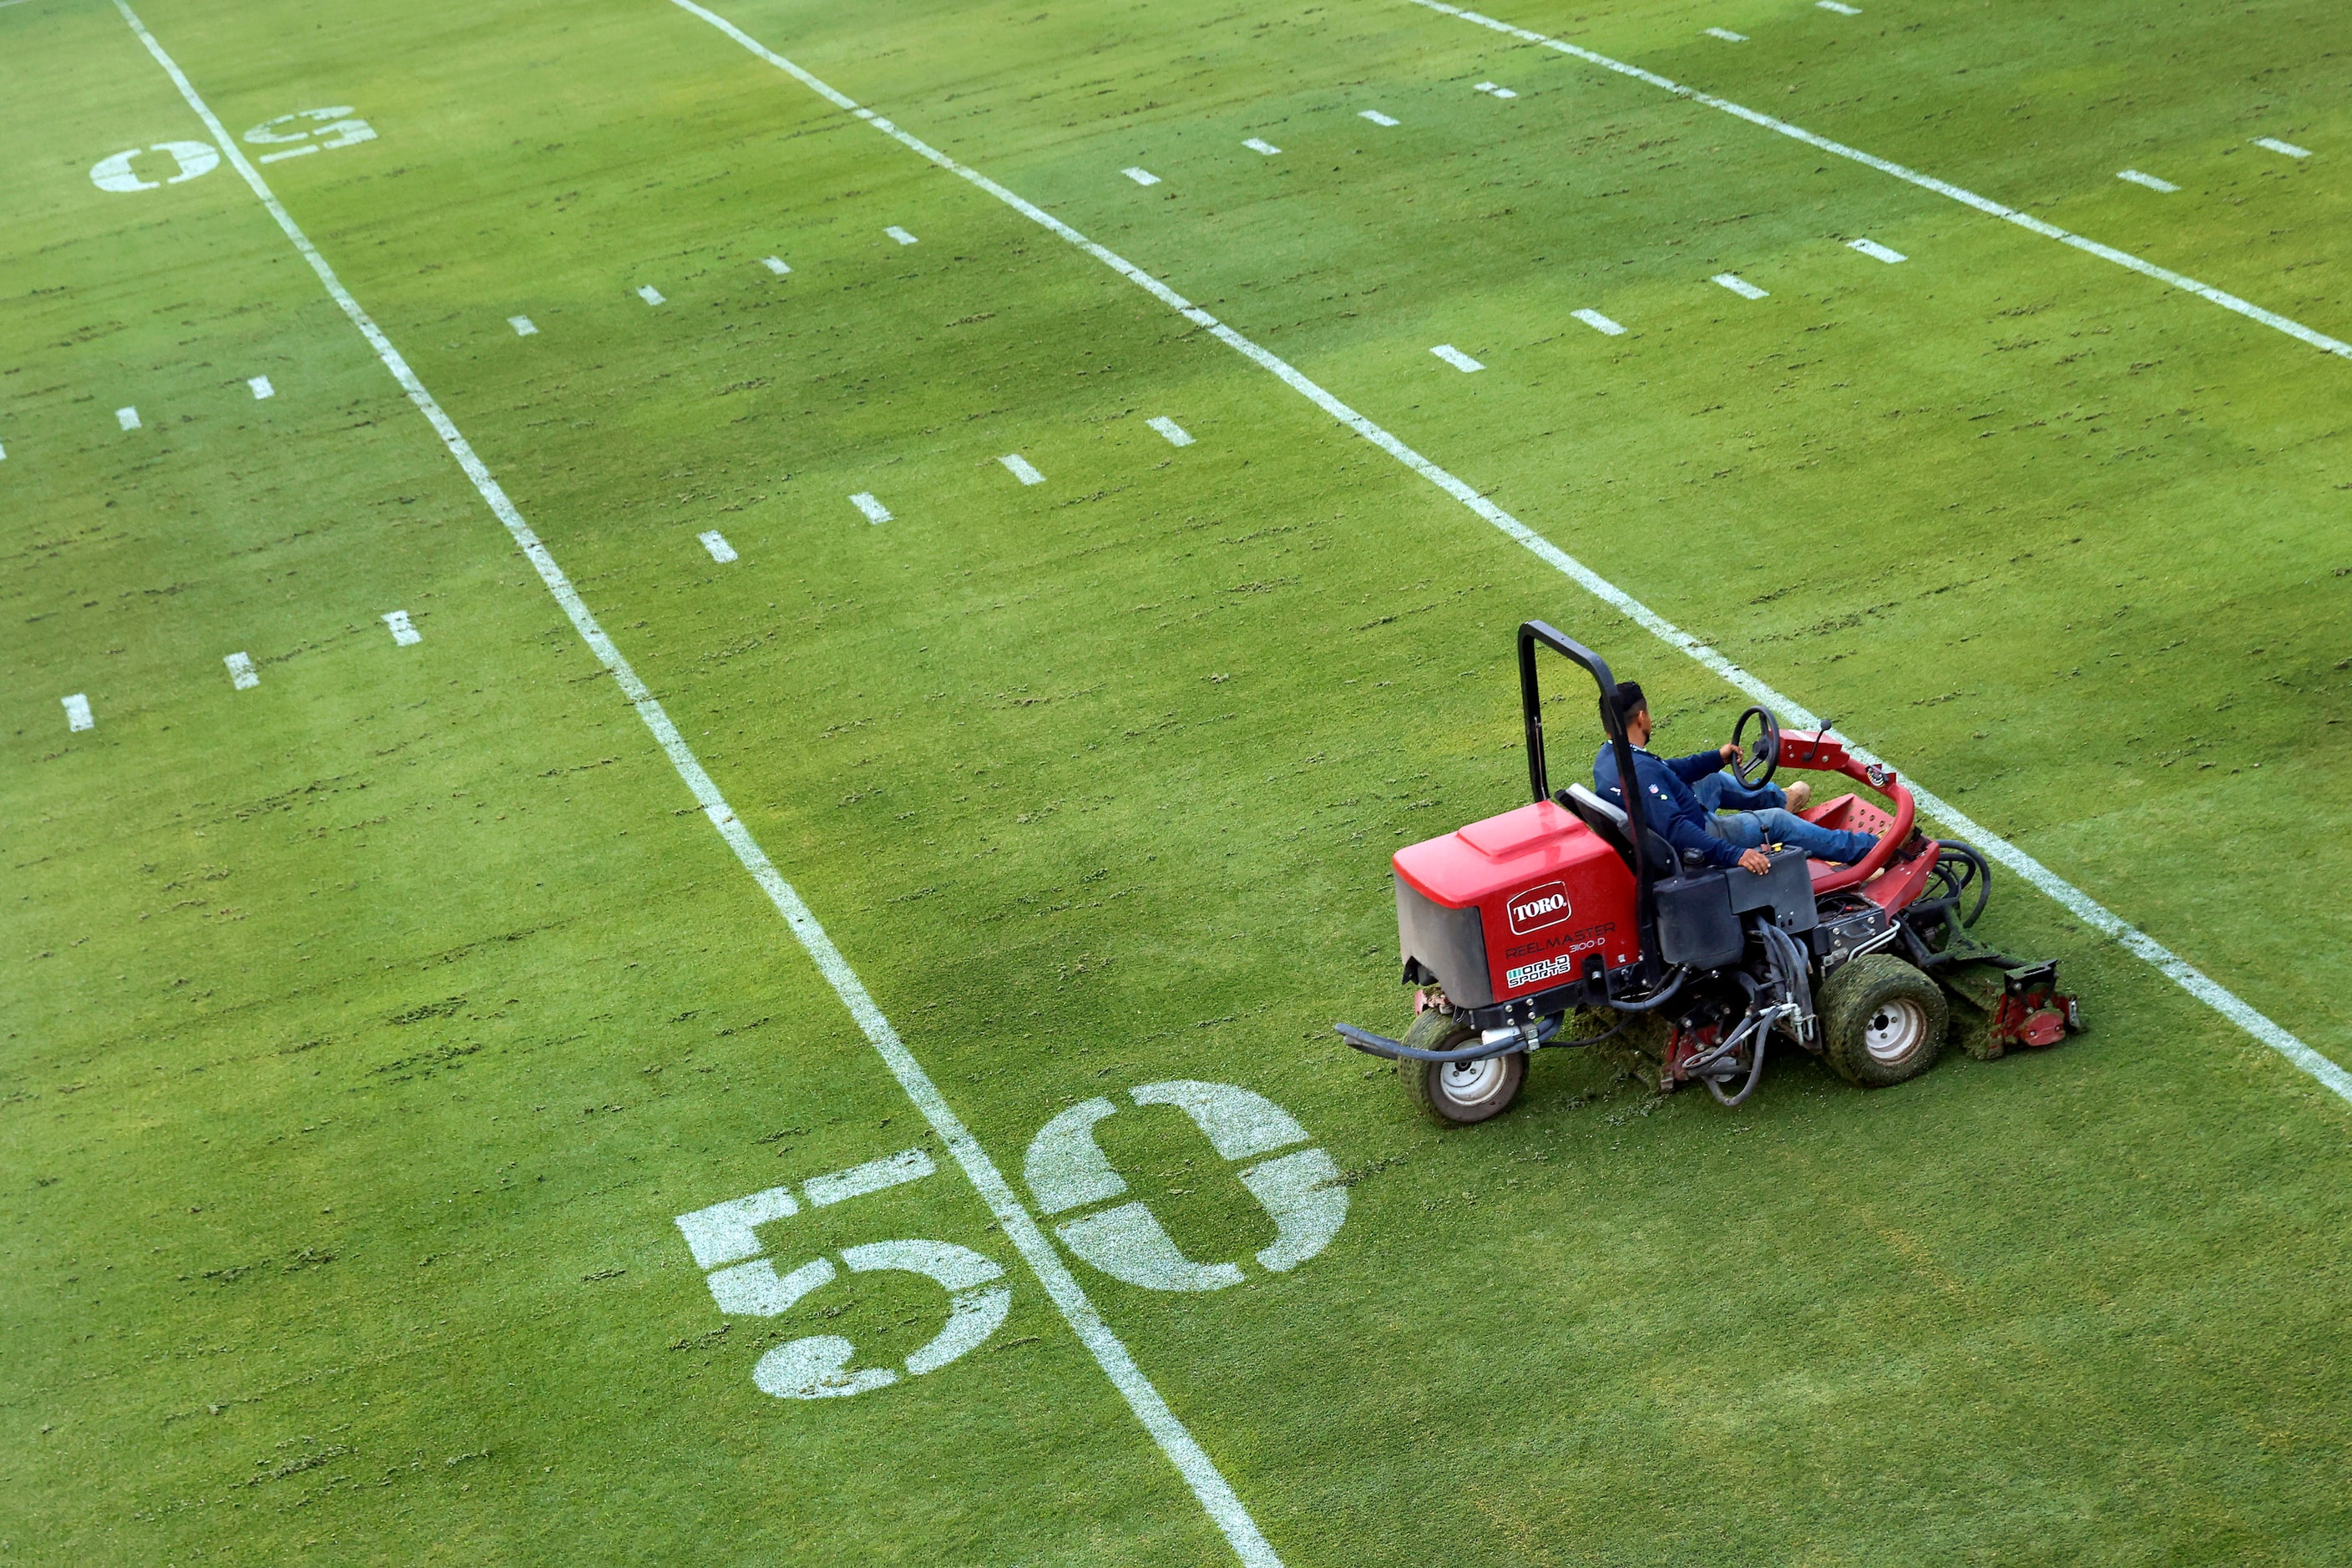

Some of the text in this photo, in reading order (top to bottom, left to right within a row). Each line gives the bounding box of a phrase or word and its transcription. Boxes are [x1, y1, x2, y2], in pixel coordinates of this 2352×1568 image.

[1505, 922, 1616, 959] REELMASTER
[1510, 964, 1569, 987] SPORTS
[674, 1080, 1352, 1399] 50
